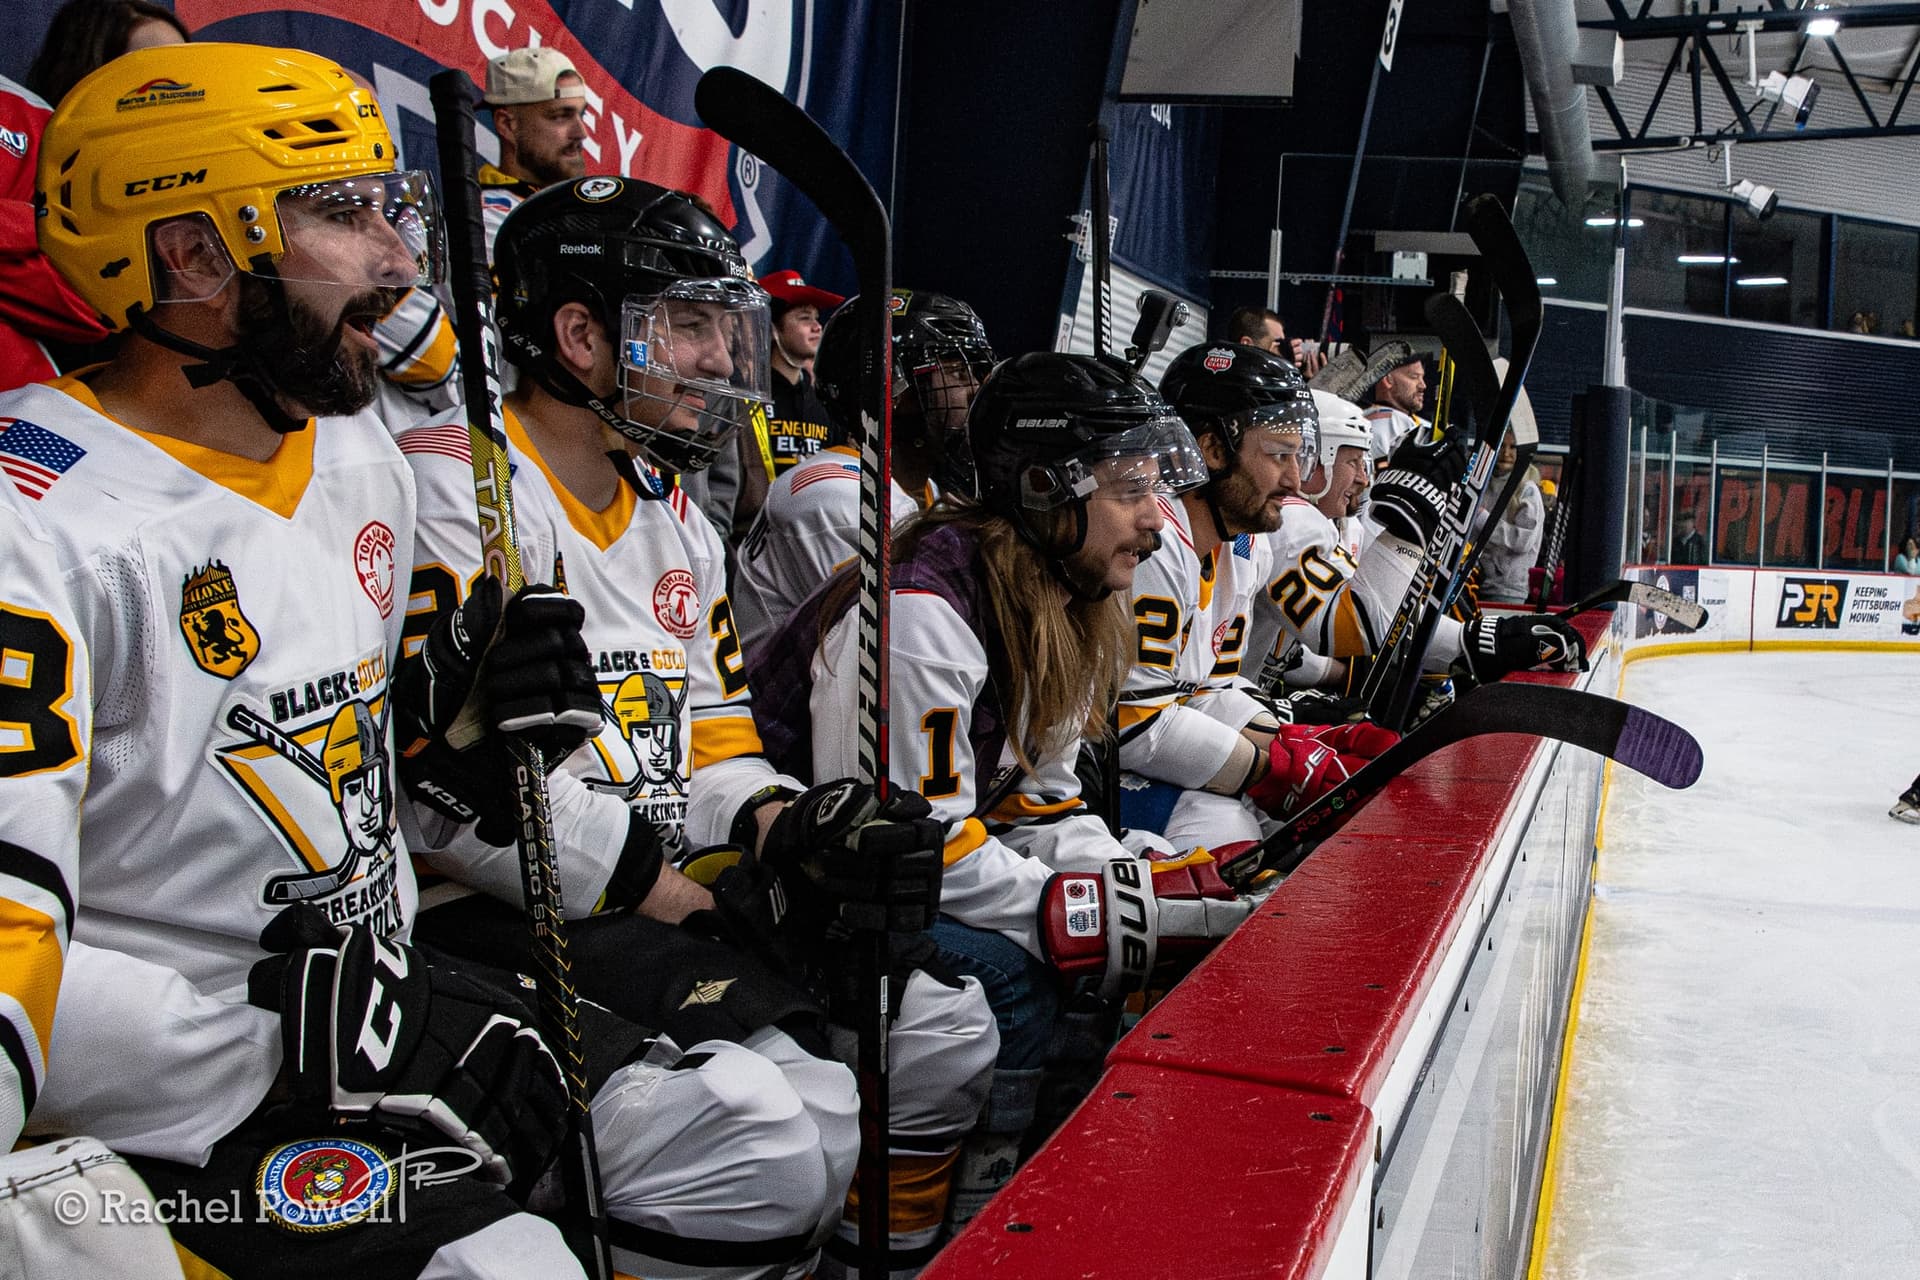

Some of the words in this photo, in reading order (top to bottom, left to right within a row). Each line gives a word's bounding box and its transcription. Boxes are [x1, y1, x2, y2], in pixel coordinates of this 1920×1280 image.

[124, 168, 208, 197] CCM
[560, 242, 601, 256] Reebok
[1015, 418, 1069, 429] BAUER
[1265, 543, 1344, 632] 20
[1855, 586, 1888, 598] KEEPING
[1780, 583, 1840, 623] P3R
[1851, 599, 1901, 611] PITTSBURGH
[1848, 612, 1881, 623] MOVING
[586, 651, 639, 673] LACK
[269, 671, 350, 724] BLACK
[919, 707, 962, 800] 1
[516, 765, 542, 896] CLASSIC
[534, 903, 548, 937] SE
